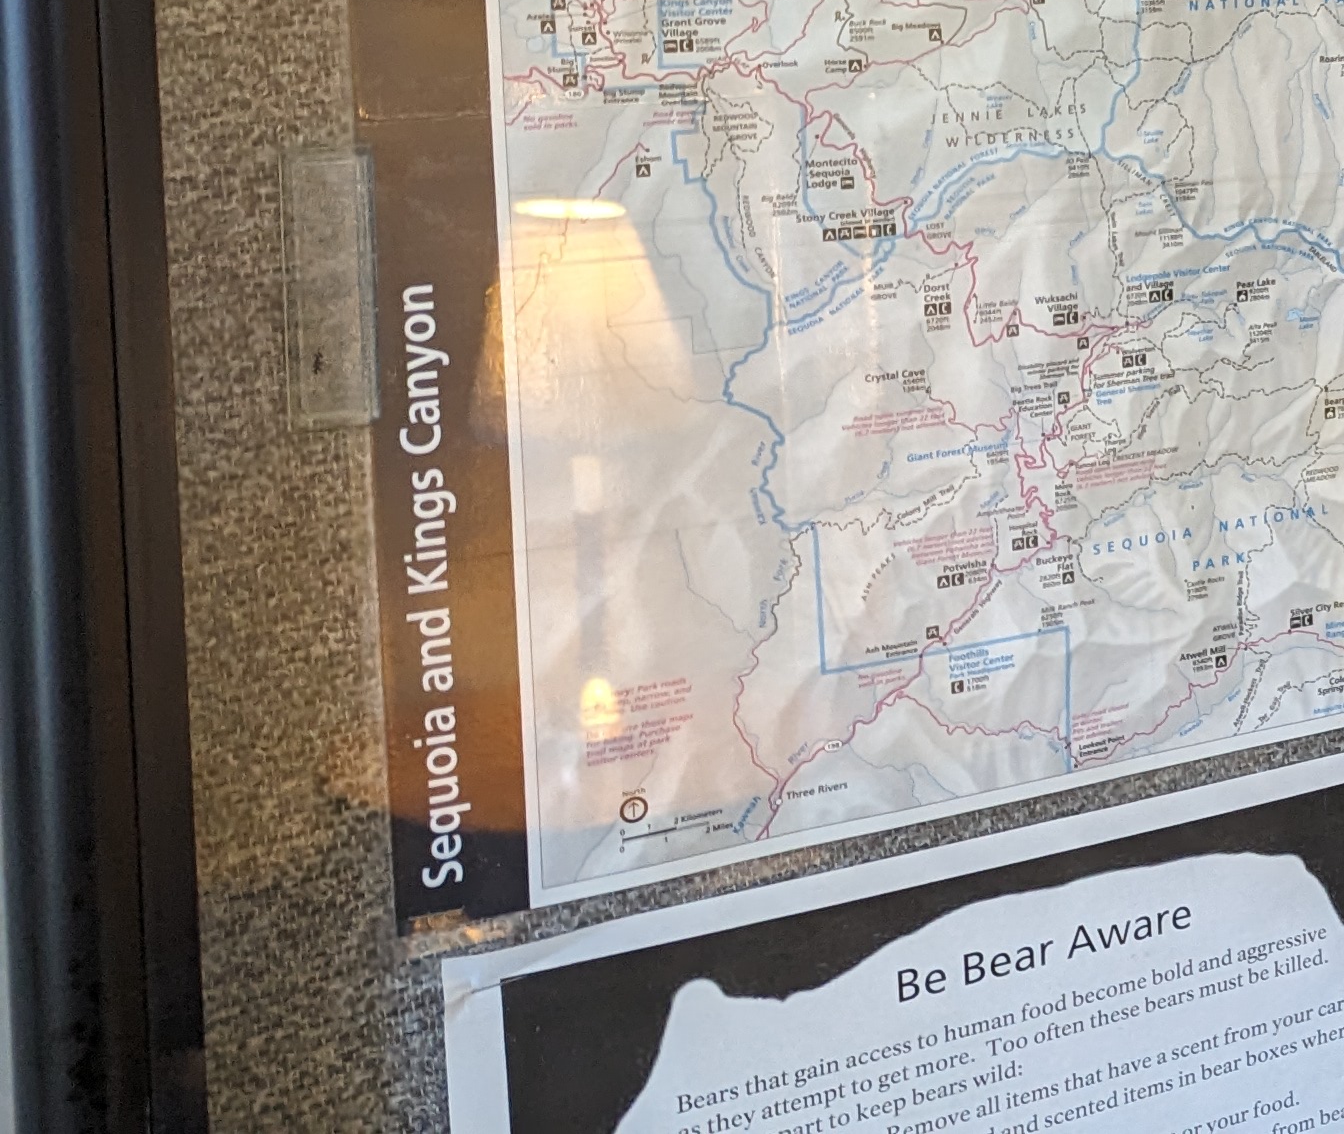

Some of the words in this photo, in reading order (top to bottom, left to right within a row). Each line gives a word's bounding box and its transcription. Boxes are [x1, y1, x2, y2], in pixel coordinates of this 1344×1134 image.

[662, 18, 689, 28] Grant
[692, 17, 726, 27] Grove
[662, 27, 699, 38] Village
[930, 109, 1003, 125] JENNIE
[1027, 103, 1088, 118] LAKES
[946, 128, 1075, 147] WILDERNESS
[805, 158, 858, 170] Montecito
[806, 178, 837, 189] Lodge
[796, 211, 825, 224] Stony
[828, 210, 857, 221] Creek
[860, 207, 895, 219] Village
[1126, 271, 1170, 283] Lodgepole
[1172, 267, 1200, 278] Visitor
[1202, 264, 1231, 275] Center
[924, 284, 951, 293] Dorst
[1126, 284, 1143, 292] and
[1146, 280, 1174, 290] Village
[924, 293, 951, 303] Creek
[1035, 293, 1079, 305] Wuksachi
[1047, 302, 1079, 312] Village
[398, 282, 452, 456] Canyon
[865, 372, 897, 384] Crystal
[900, 369, 926, 378] Cave
[403, 467, 454, 594] Kings
[1092, 527, 1194, 555] SEQUOIA
[1219, 503, 1330, 531] NATIONAL
[1192, 552, 1247, 571] PARK
[406, 609, 453, 691] and
[414, 706, 464, 887] Sequoia
[787, 788, 818, 801] Three
[820, 781, 848, 795] Rivers
[898, 967, 947, 1002] Be
[963, 939, 1054, 985] Bear
[1067, 905, 1193, 959] Aware
[677, 1084, 739, 1114] Bears
[744, 1072, 788, 1097] that
[794, 1059, 839, 1088] gain
[845, 1041, 912, 1070] access
[918, 1033, 938, 1051] to
[944, 1013, 1015, 1043] human
[1022, 997, 1068, 1022] food
[1072, 974, 1148, 1007] become
[1152, 961, 1194, 986] bold
[1198, 948, 1233, 972] and
[1237, 926, 1328, 965] aggressive
[707, 1109, 755, 1134] they
[761, 1085, 846, 1118] attempt
[851, 1076, 872, 1095] to
[878, 1067, 910, 1093] get
[915, 1052, 975, 1076] more.
[985, 1036, 1027, 1057] Too
[1033, 1020, 1085, 1045] often
[1090, 1006, 1141, 1028] these
[1145, 987, 1195, 1014] bears
[1199, 975, 1244, 999] must
[1248, 967, 1270, 984] be
[1274, 951, 1328, 979] killed.
[976, 1096, 1000, 1117] all
[1006, 1083, 1060, 1109] items
[1064, 1069, 1103, 1092] that
[1108, 1054, 1152, 1080] have
[1156, 1051, 1168, 1065] a
[1171, 1035, 1220, 1061] scent
[1223, 1021, 1269, 1046] from
[1272, 1011, 1312, 1039] your
[1044, 1092, 1119, 1127] scented
[1123, 1075, 1174, 1105] items
[1179, 1071, 1197, 1088] in
[1200, 1058, 1242, 1082] bear
[1246, 1040, 1299, 1066] boxes
[828, 1109, 850, 1127] to
[857, 1096, 906, 1122] keep
[912, 1076, 968, 1106] bears
[973, 1061, 1023, 1088] wild:
[1206, 1105, 1250, 1134] your
[1252, 1092, 1300, 1117] food.
